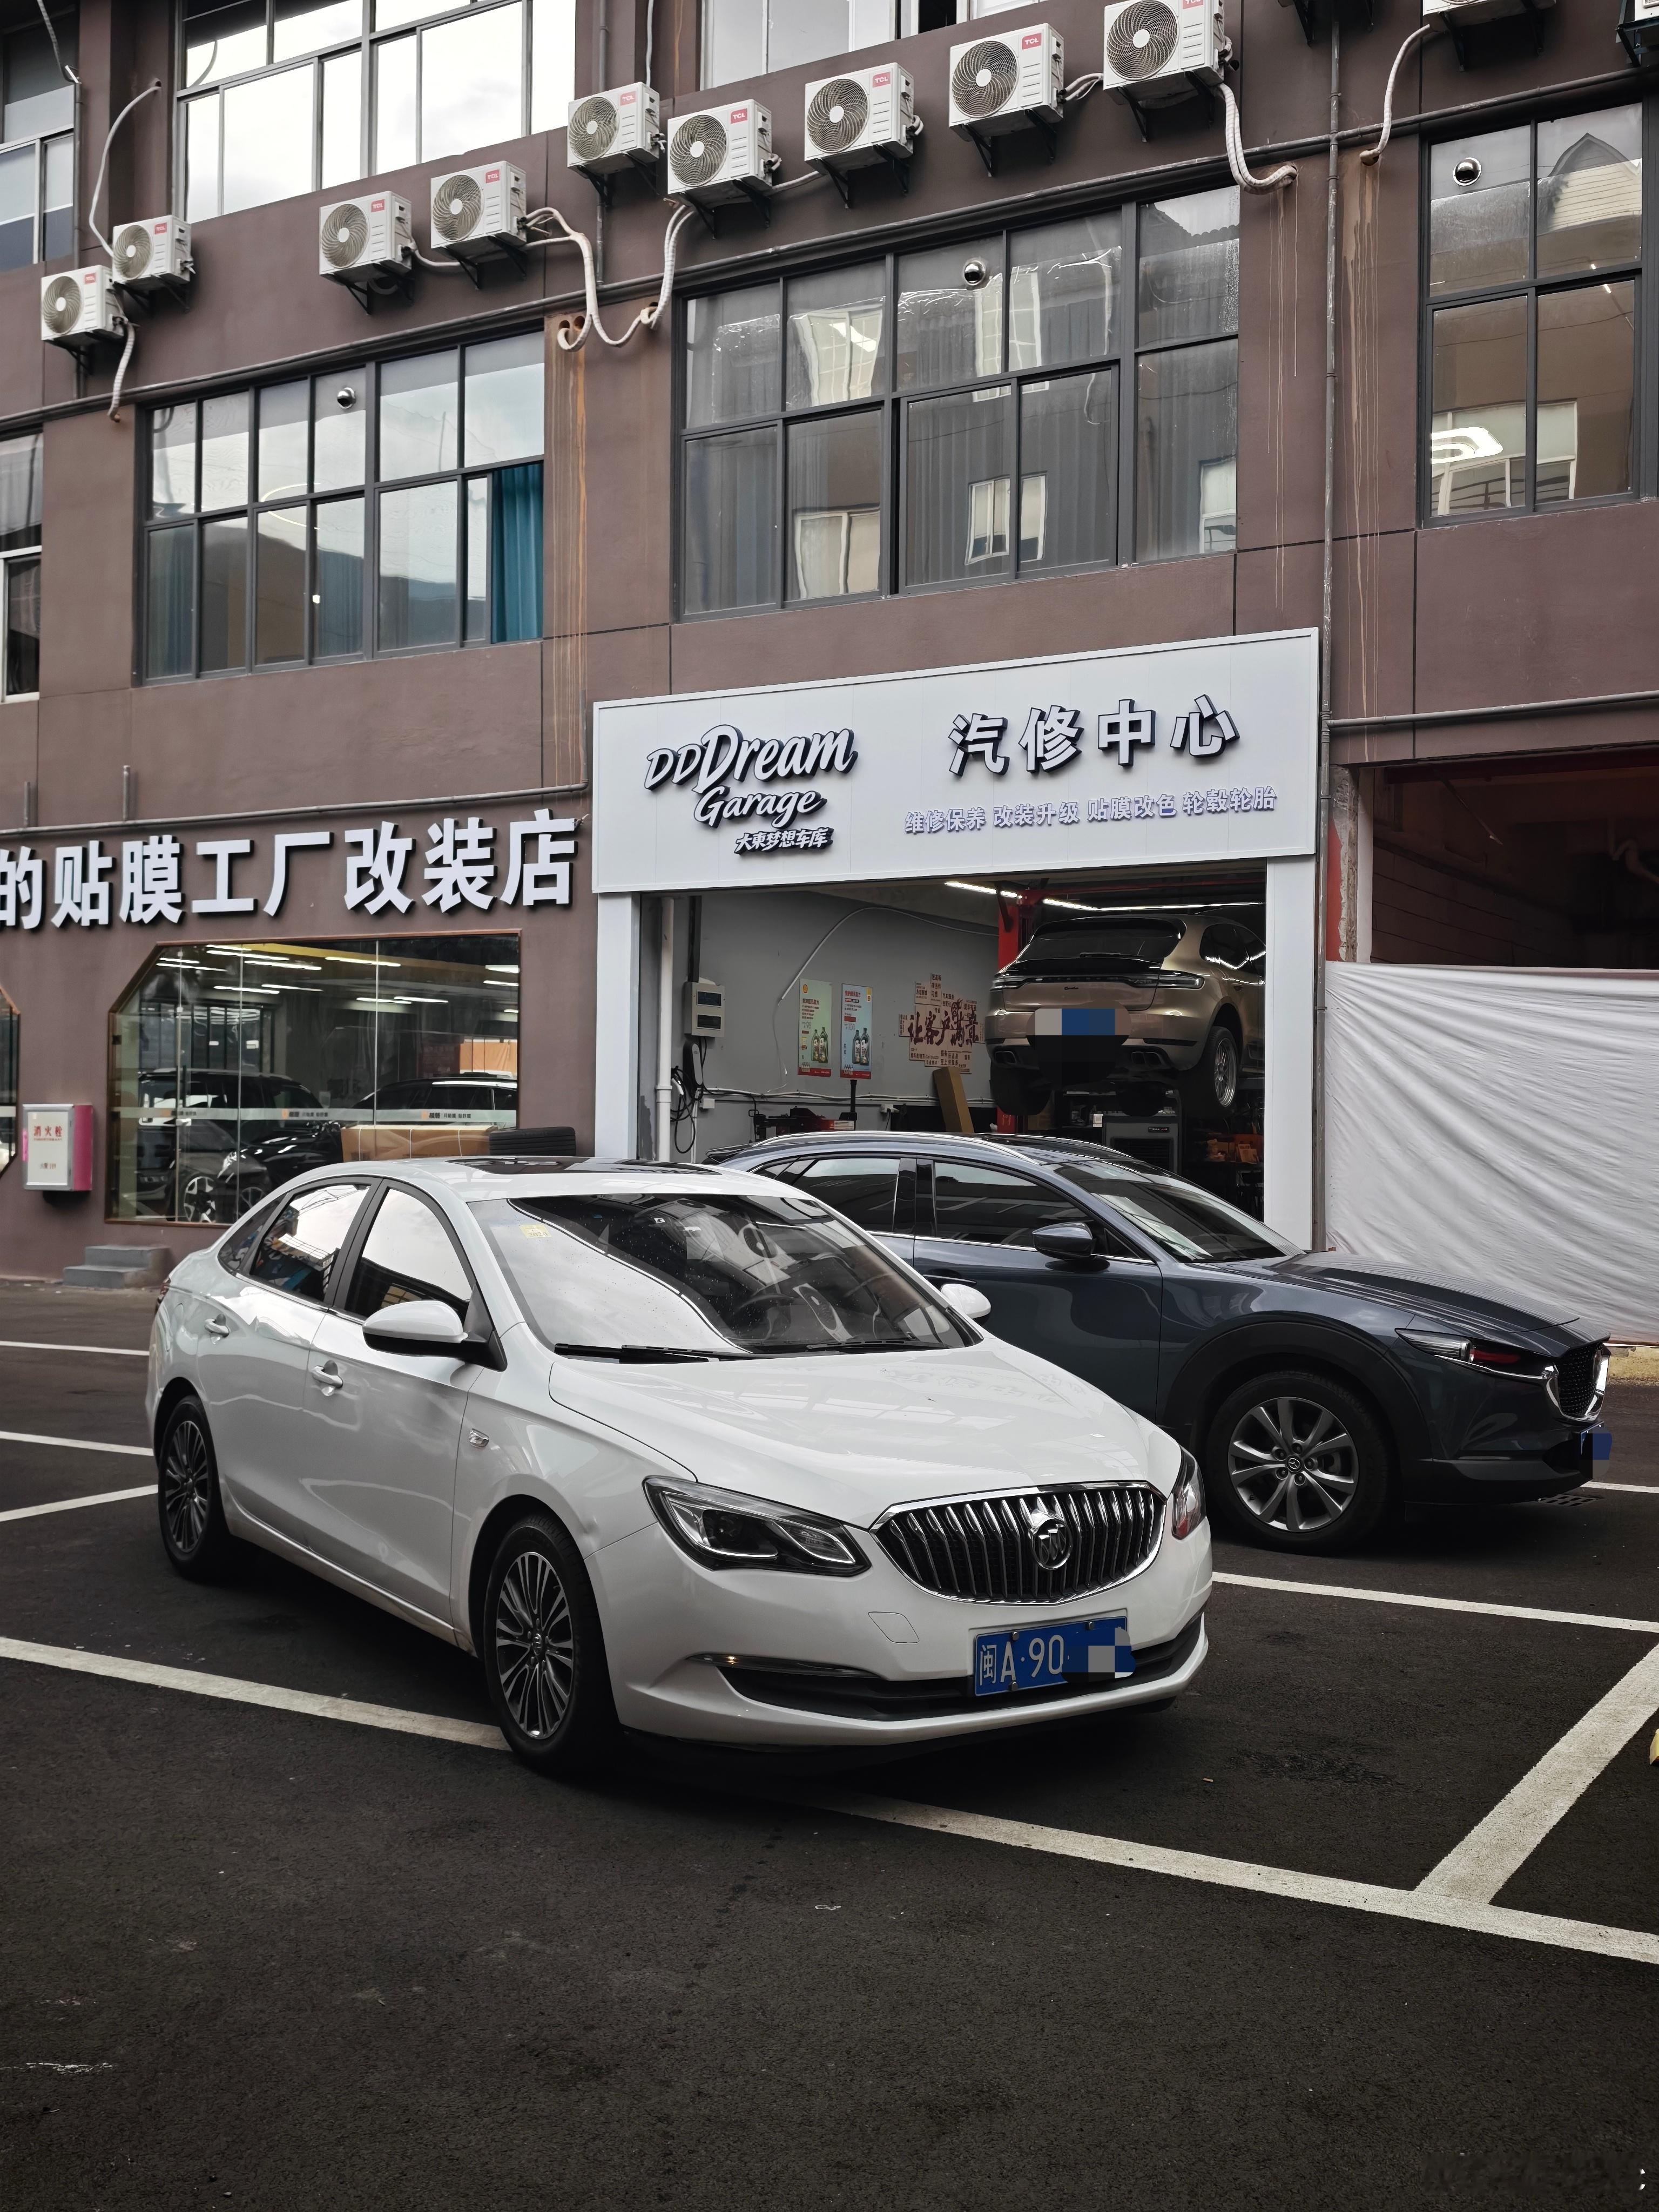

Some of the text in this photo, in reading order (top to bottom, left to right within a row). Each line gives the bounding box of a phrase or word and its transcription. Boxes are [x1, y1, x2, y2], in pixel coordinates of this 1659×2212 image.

[948, 694, 1240, 776] 汽修中心
[694, 785, 827, 829] Garage
[905, 786, 1278, 834] 维修保养 改装升级 贴膜改色 轮毂轮胎
[0, 808, 576, 929] 的贴膜工厂改装店
[33, 1125, 63, 1137] 消火栓
